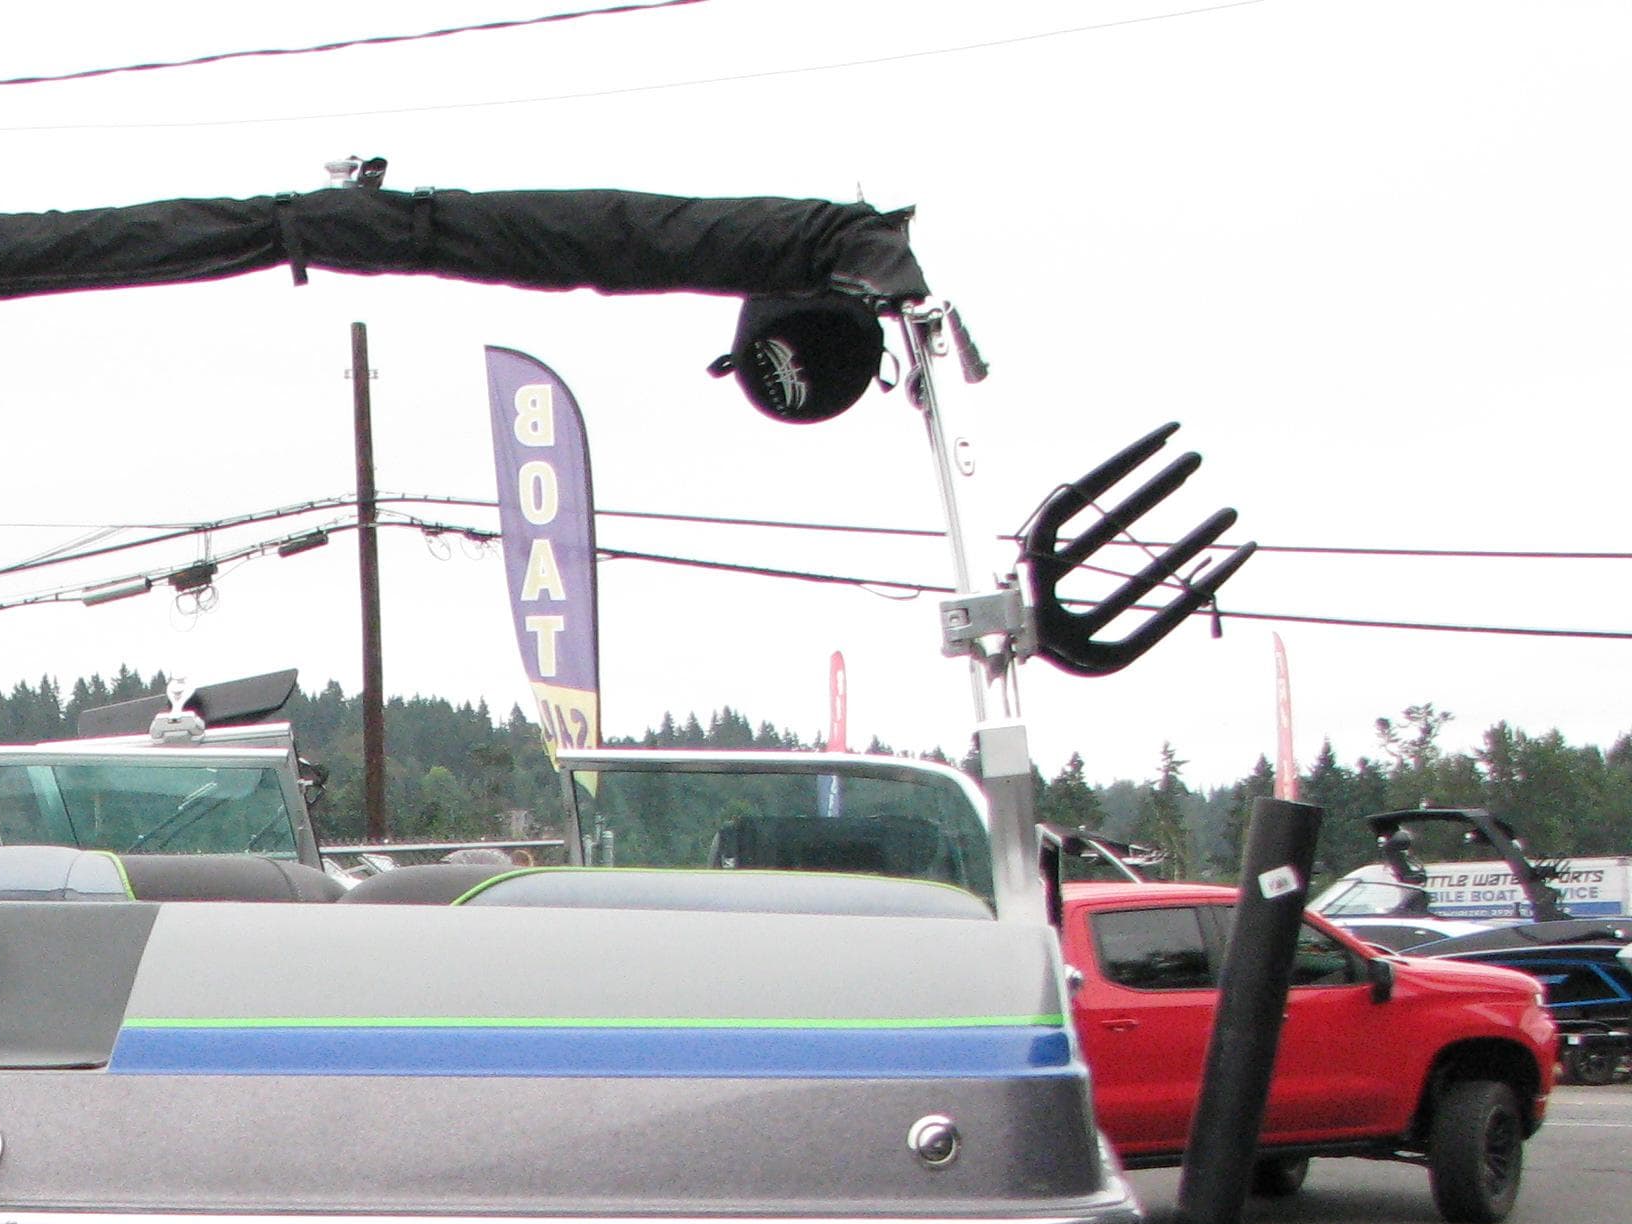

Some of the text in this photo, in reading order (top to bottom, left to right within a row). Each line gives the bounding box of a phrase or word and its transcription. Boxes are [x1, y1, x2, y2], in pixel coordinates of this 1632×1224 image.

[1424, 870, 1604, 887] TTLE WATE ORTS
[1471, 889, 1517, 902] BOAT
